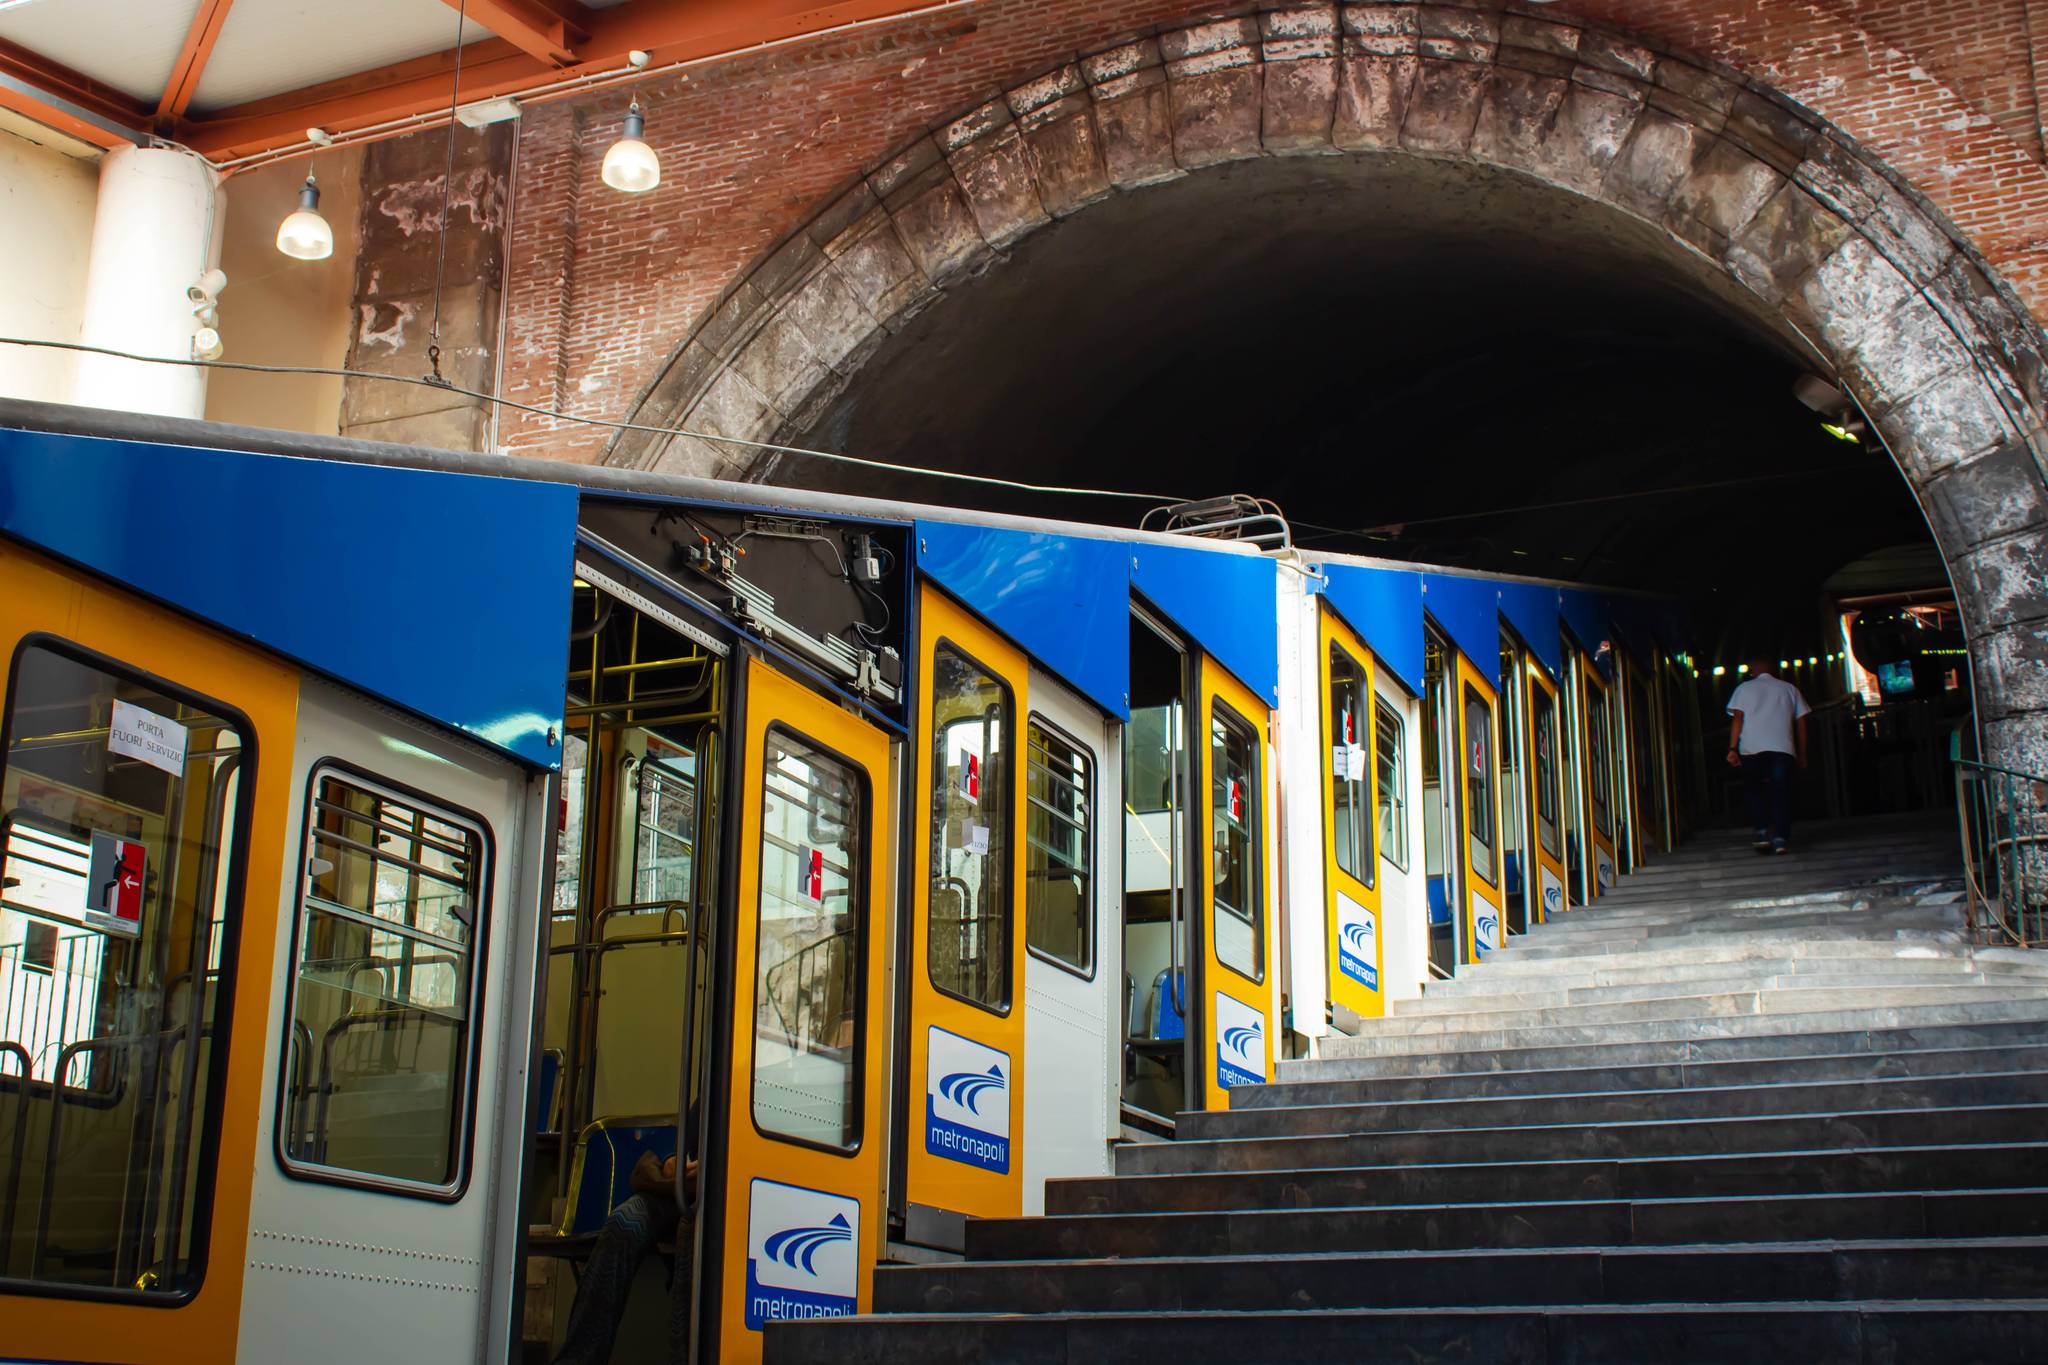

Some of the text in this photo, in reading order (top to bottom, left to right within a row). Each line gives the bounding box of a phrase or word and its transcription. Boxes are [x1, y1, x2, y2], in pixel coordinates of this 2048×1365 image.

[137, 719, 164, 738] PORTA
[112, 729, 183, 763] FUORI SERVIZIO
[931, 1126, 1005, 1163] metronapoli
